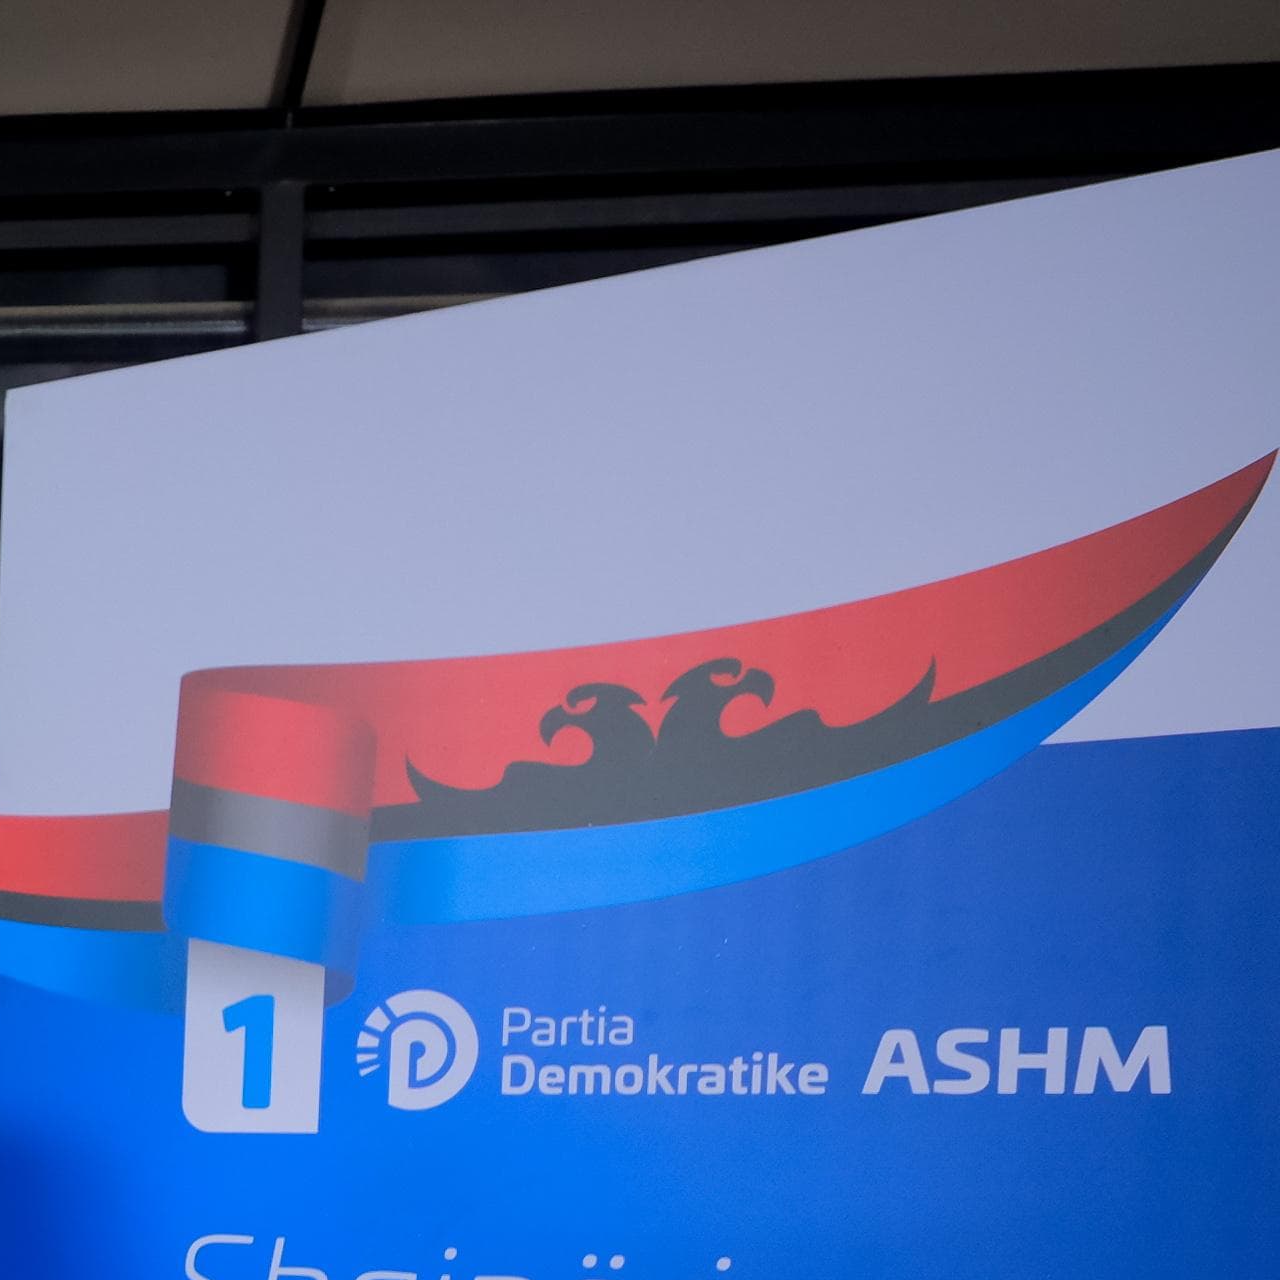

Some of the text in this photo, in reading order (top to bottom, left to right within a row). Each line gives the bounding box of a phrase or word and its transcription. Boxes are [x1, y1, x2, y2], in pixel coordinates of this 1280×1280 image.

[222, 994, 274, 1109] 1
[501, 1006, 634, 1046] Partia
[501, 1051, 829, 1095] Demokratike
[861, 1025, 1171, 1095] ASHM
